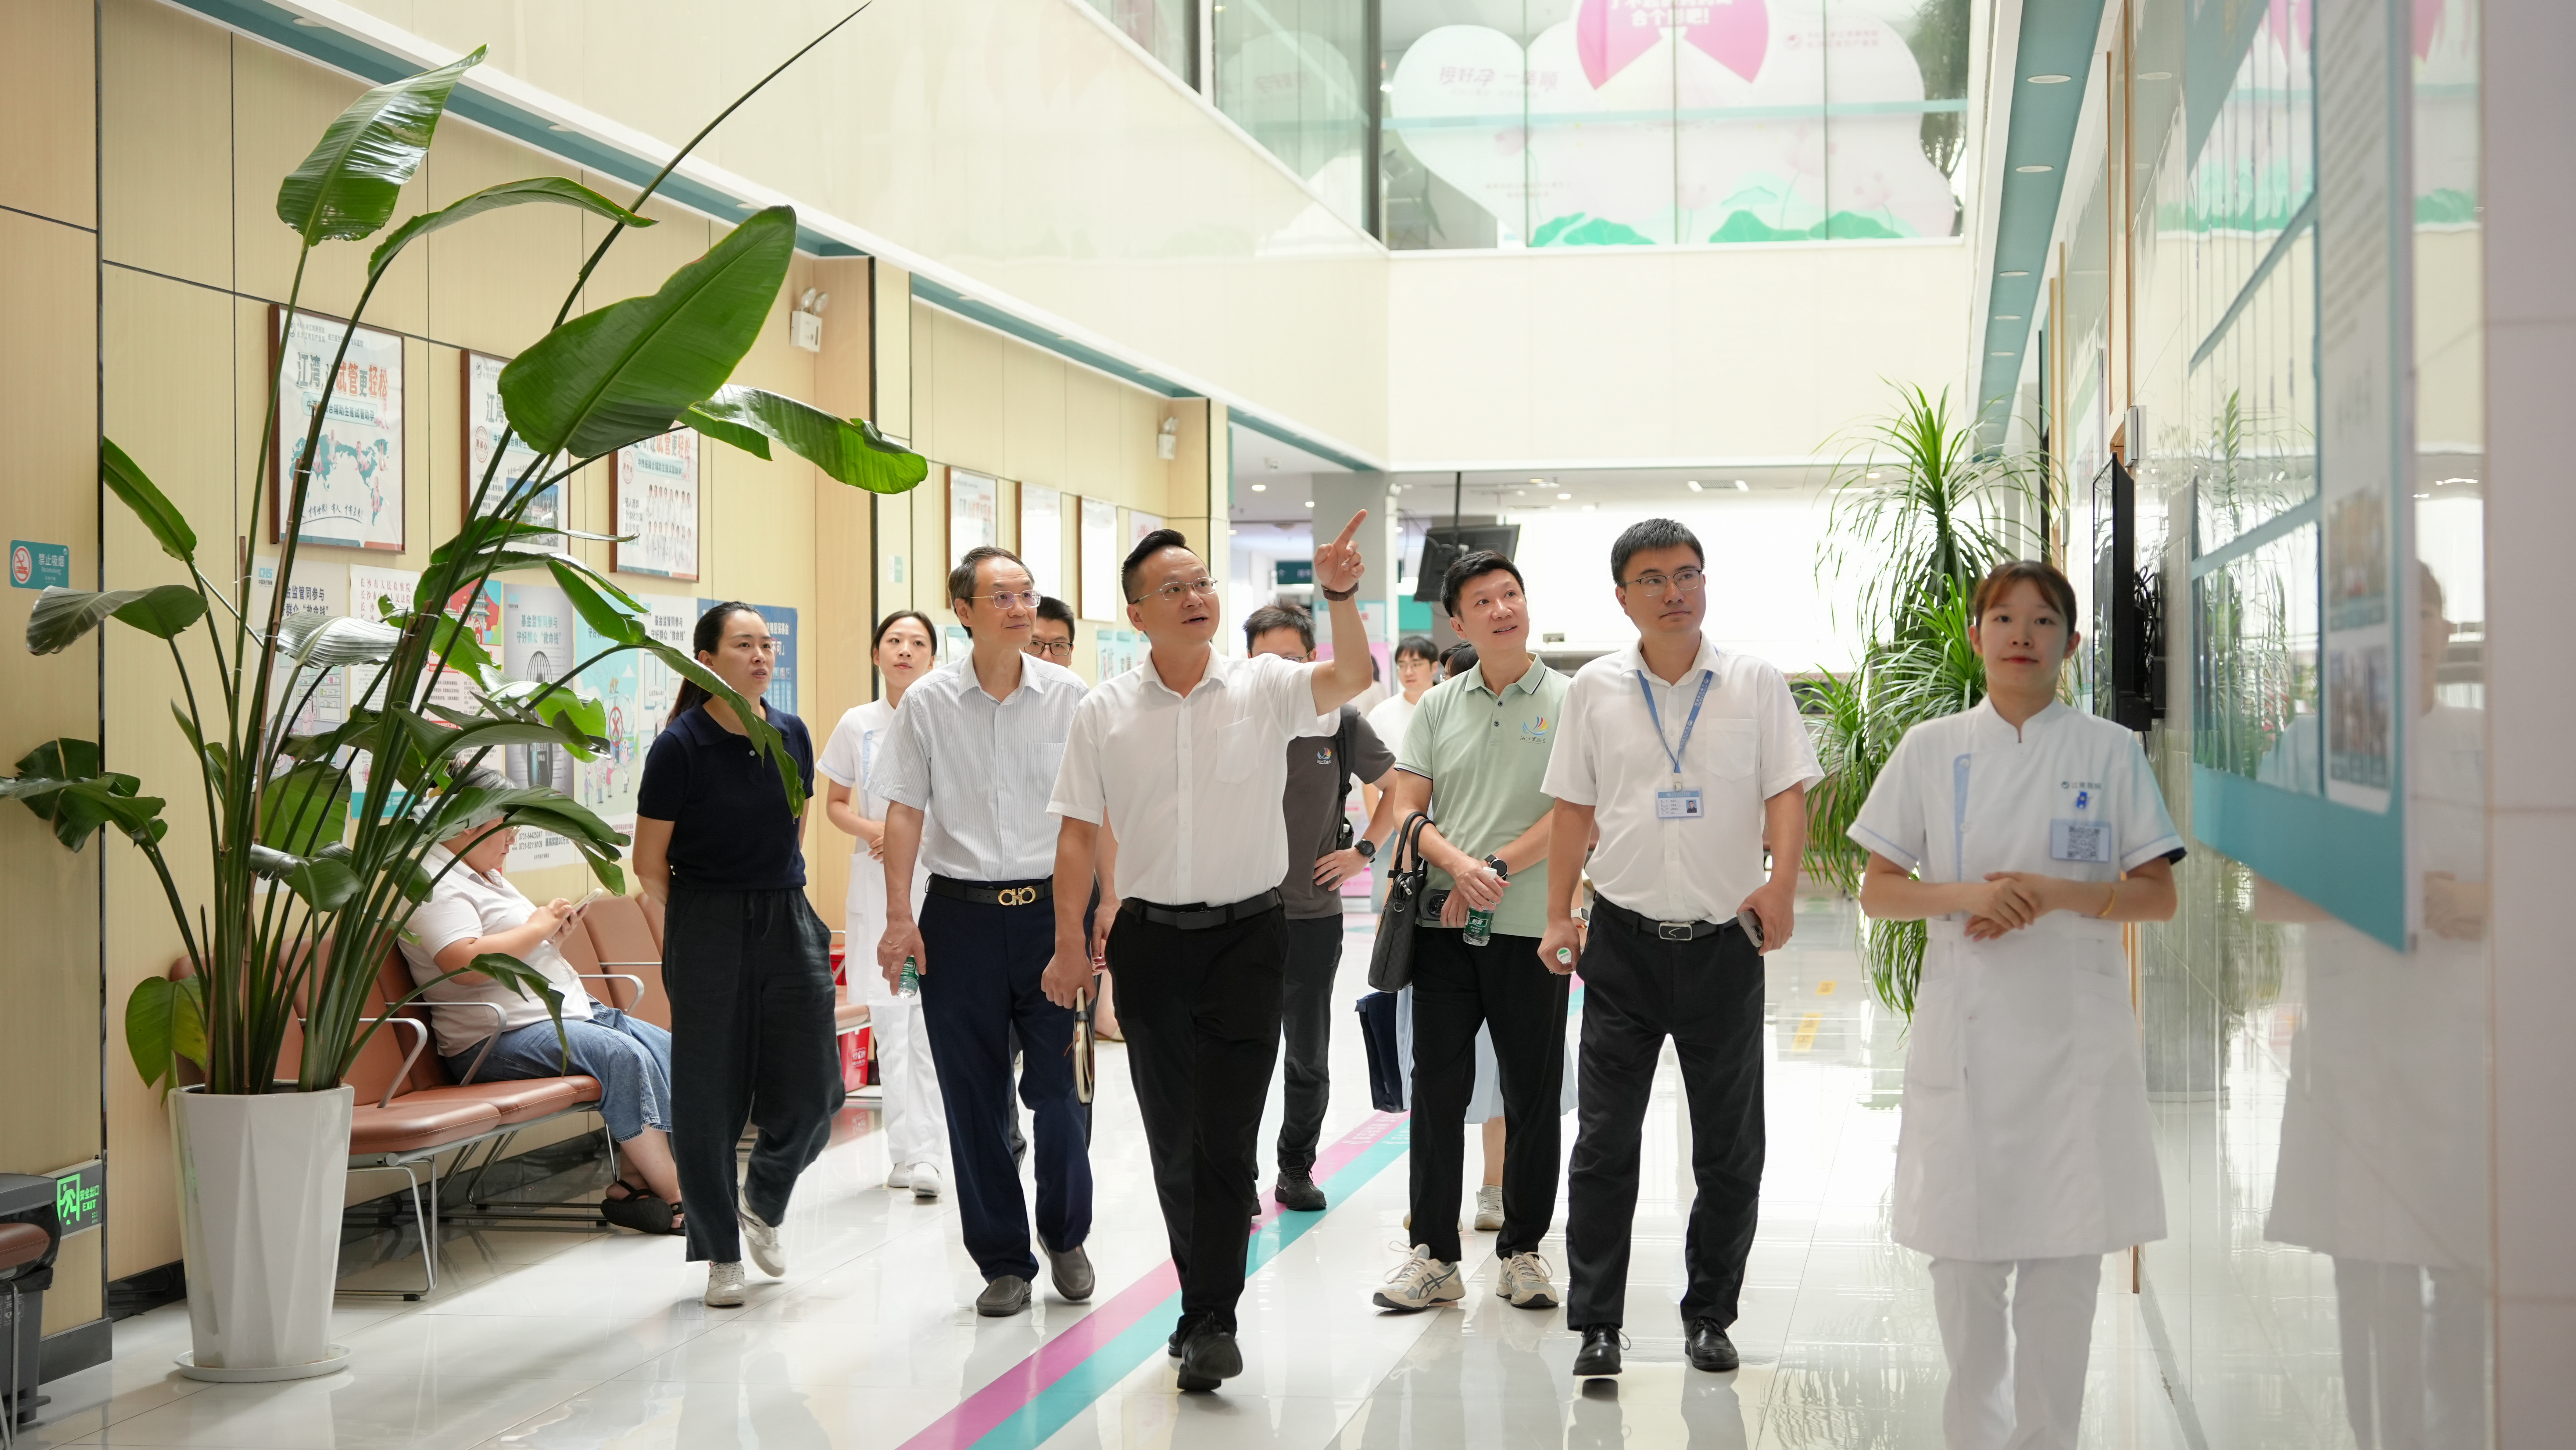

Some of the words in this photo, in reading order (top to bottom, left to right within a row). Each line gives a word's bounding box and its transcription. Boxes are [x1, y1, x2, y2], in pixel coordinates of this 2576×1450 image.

[476, 439, 487, 450] 更省心
[638, 458, 681, 475] 中西医融合辅助生殖试管助孕
[625, 497, 639, 508] 因人而异
[626, 510, 643, 522] 个体化方案
[38, 553, 65, 567] 禁止吸烟
[361, 578, 411, 592] 长沙市人民检察院
[361, 590, 411, 604] 长沙市中人民法院
[521, 614, 557, 628] 基金监管同参与
[655, 615, 683, 627] 基金监管同参与
[519, 831, 543, 840] 0731-84425247
[519, 841, 543, 850] 0731-82116109
[80, 1185, 99, 1201] 安全出口
[82, 1199, 97, 1211] EXIT
